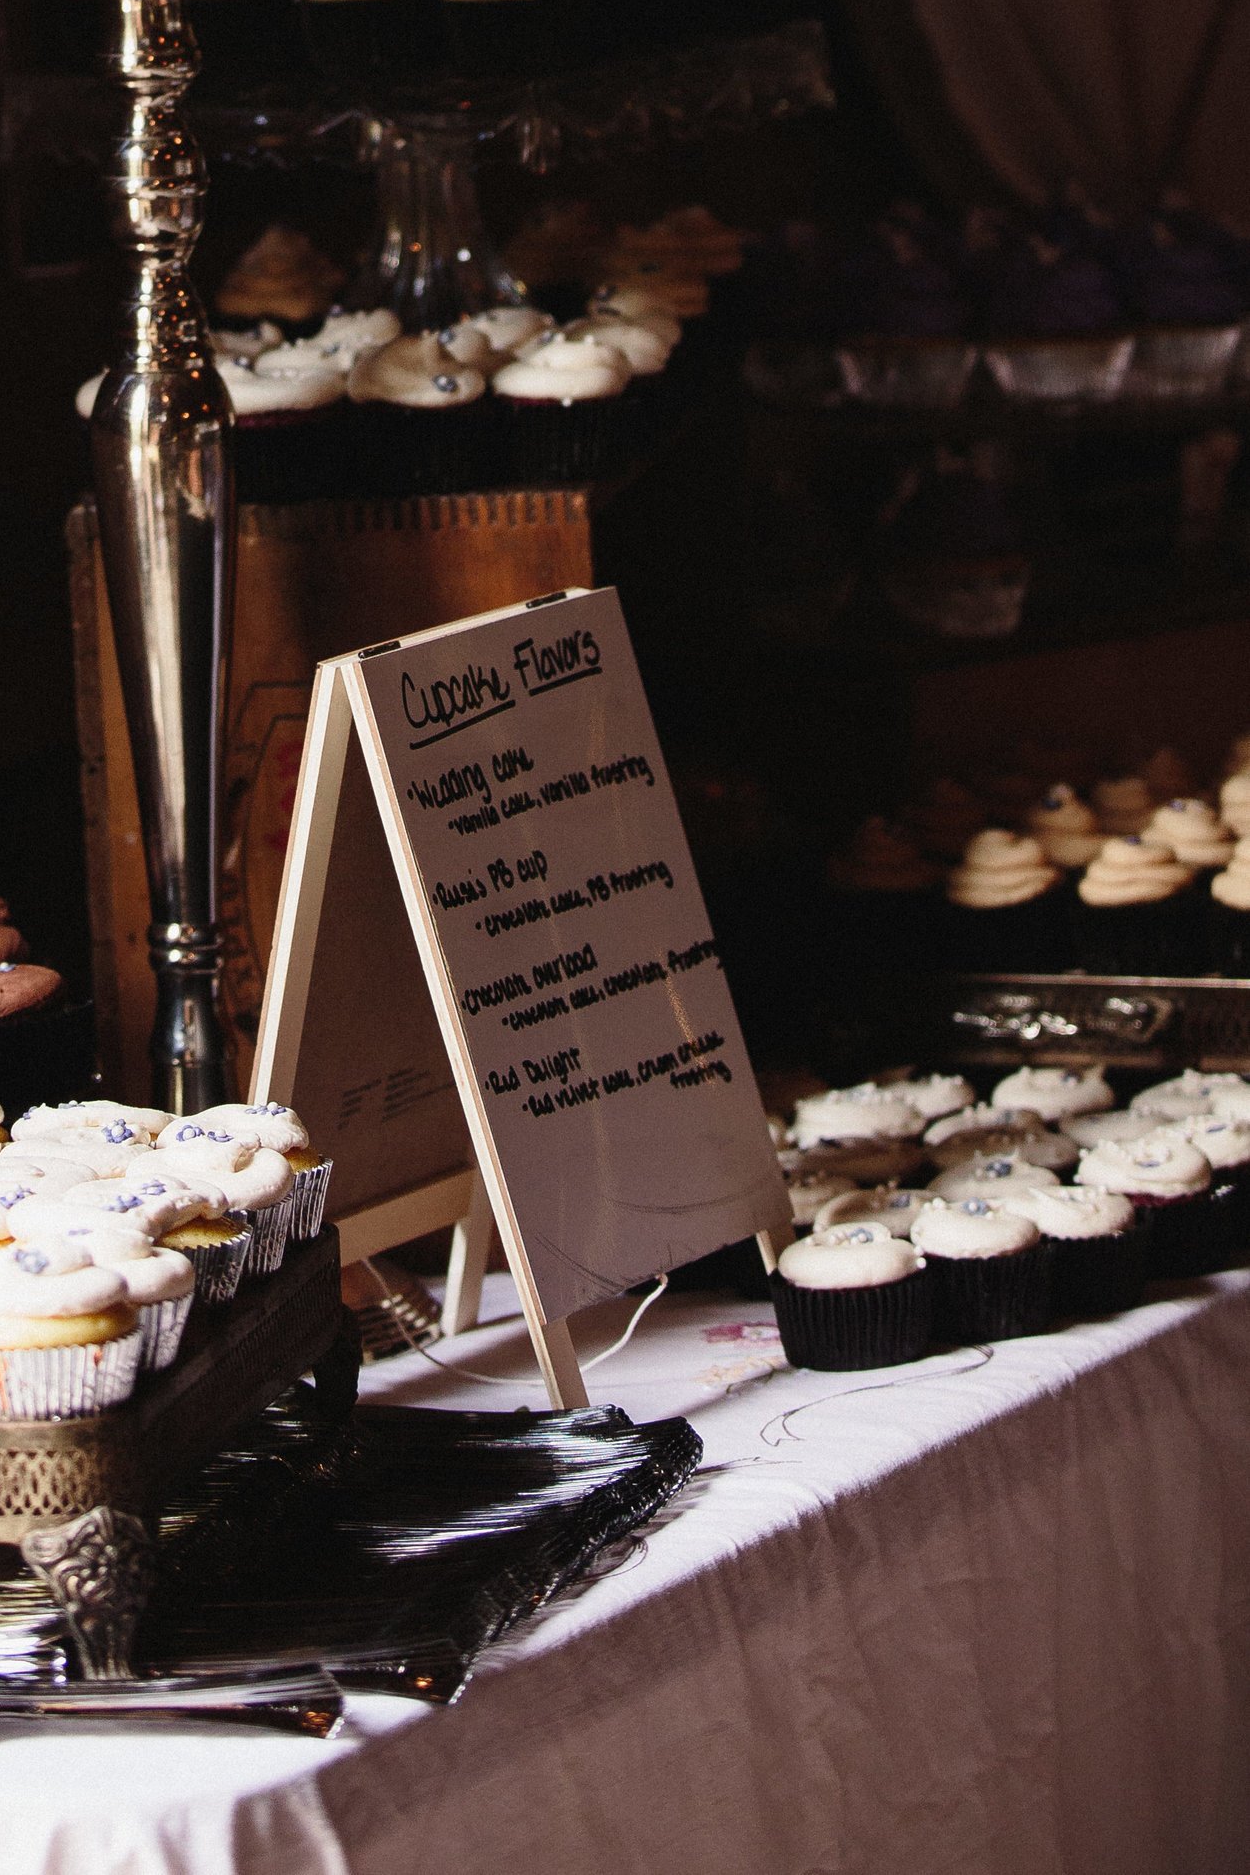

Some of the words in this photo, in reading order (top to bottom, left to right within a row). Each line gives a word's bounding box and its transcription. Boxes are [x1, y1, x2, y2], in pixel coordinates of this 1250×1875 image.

[402, 664, 511, 728] Cupcake
[514, 629, 601, 688] Flavors
[411, 762, 492, 810] Wedding
[492, 747, 534, 782] cake
[591, 754, 655, 788] frosting
[487, 858, 514, 893] PB
[516, 850, 548, 882] cup
[586, 875, 611, 902] PB
[488, 1065, 521, 1095] Red
[522, 1047, 582, 1084] Delight
